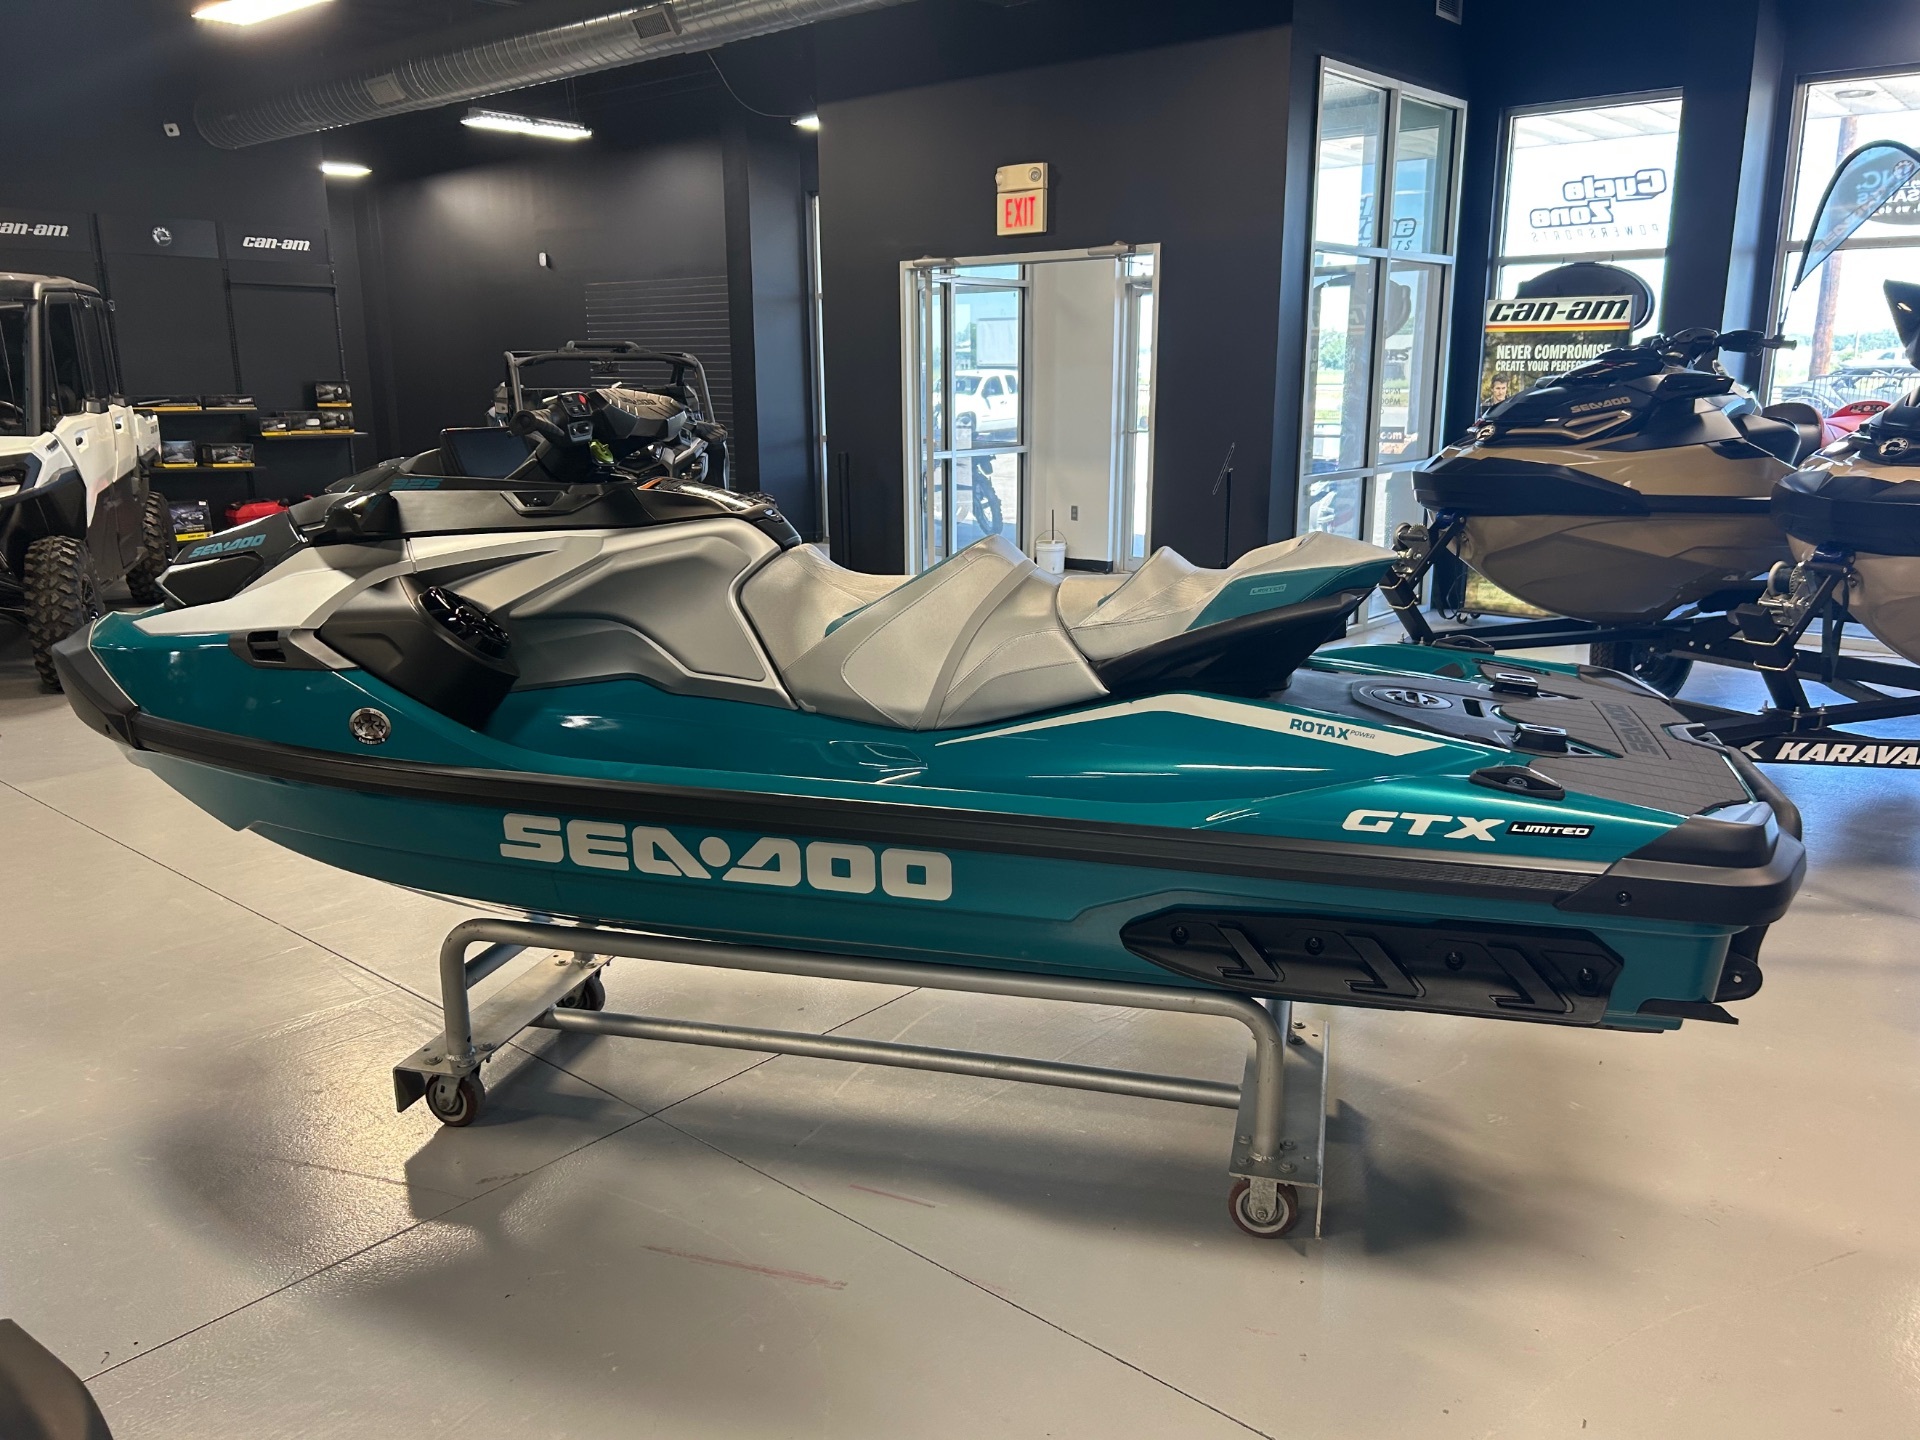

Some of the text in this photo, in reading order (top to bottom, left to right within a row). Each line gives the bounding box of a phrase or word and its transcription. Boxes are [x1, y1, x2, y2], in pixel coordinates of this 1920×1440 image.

[1005, 196, 1036, 228] EXIT
[0, 222, 68, 237] an-am
[243, 236, 310, 251] can-am
[1489, 300, 1629, 322] can-am
[1496, 344, 1611, 360] NEVER COMPROMIS
[1495, 360, 1526, 372] CREATE
[1527, 360, 1549, 372] YOUR
[1289, 718, 1376, 740] ROTAX POWER
[1775, 741, 1920, 766] KARAVA
[1342, 809, 1590, 841] GTX LIMITED
